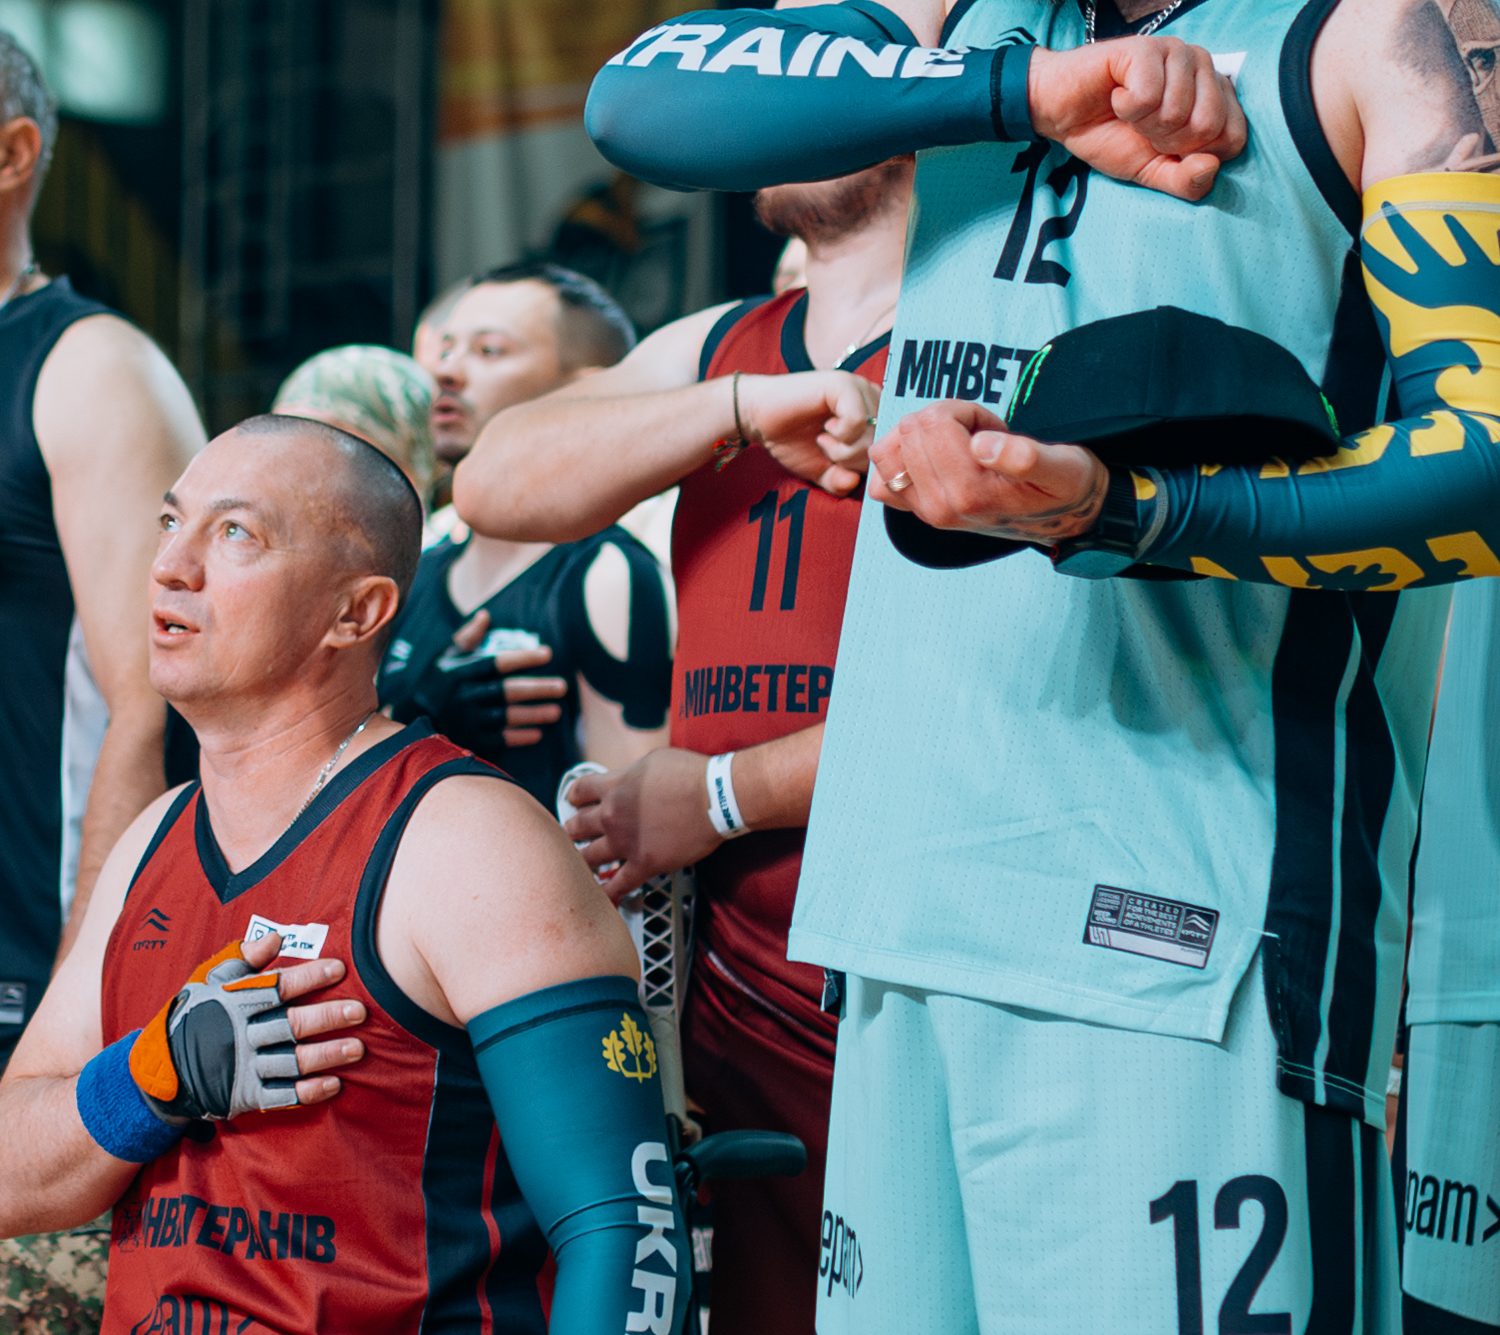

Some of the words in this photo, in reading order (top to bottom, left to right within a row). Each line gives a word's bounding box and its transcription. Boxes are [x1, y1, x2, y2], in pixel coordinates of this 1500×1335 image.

[993, 141, 1092, 288] 12
[747, 489, 809, 612] 11
[1126, 904, 1144, 914] FOR
[1128, 897, 1180, 915] CREATED
